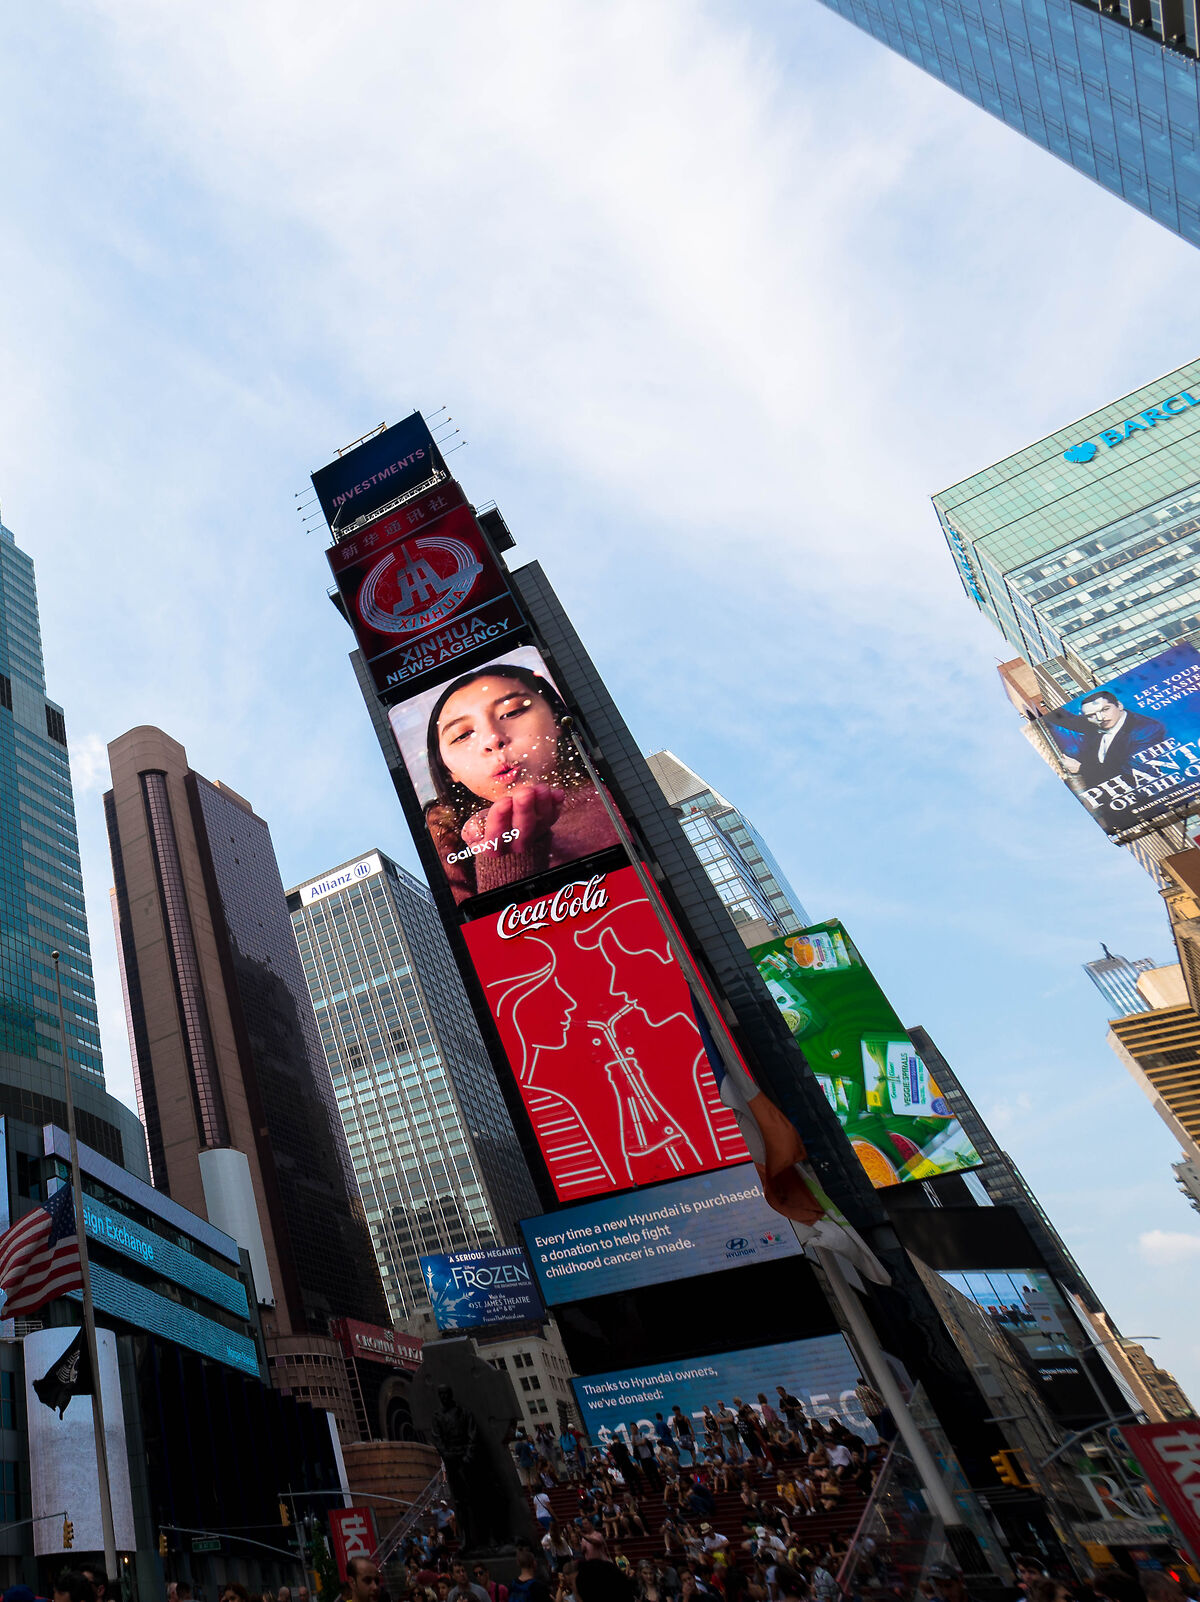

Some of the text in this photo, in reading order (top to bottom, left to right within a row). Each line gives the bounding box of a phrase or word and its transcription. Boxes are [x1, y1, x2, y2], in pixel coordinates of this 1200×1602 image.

[332, 448, 425, 508] INVESTMENTS
[400, 589, 466, 629] XINHUA
[386, 618, 510, 685] NEWS AGENCY
[399, 616, 487, 666] XINHUA
[1134, 664, 1200, 701] LET YOUR
[1132, 737, 1181, 765] THE
[1079, 740, 1200, 809] PHANT
[1109, 791, 1137, 811] OF
[1138, 772, 1185, 797] THE
[446, 828, 520, 865] Galaxy S9
[311, 872, 352, 898] Allianz
[497, 873, 608, 940] Coca-Cola
[535, 1184, 766, 1249] Every time a new Hyundai is purchased,
[106, 1215, 154, 1261] Exchange
[455, 1252, 485, 1262] SERIOUS
[540, 1224, 672, 1263] a donation to help fight
[726, 1248, 756, 1258] HYUNDAI
[451, 1261, 530, 1290] FROZEN
[545, 1237, 696, 1279] childhood cancer is made.
[484, 1296, 531, 1308] JAMES THEATRE
[582, 1365, 718, 1396] Thanks to Hyundai owners,
[587, 1389, 664, 1410] we've donated:
